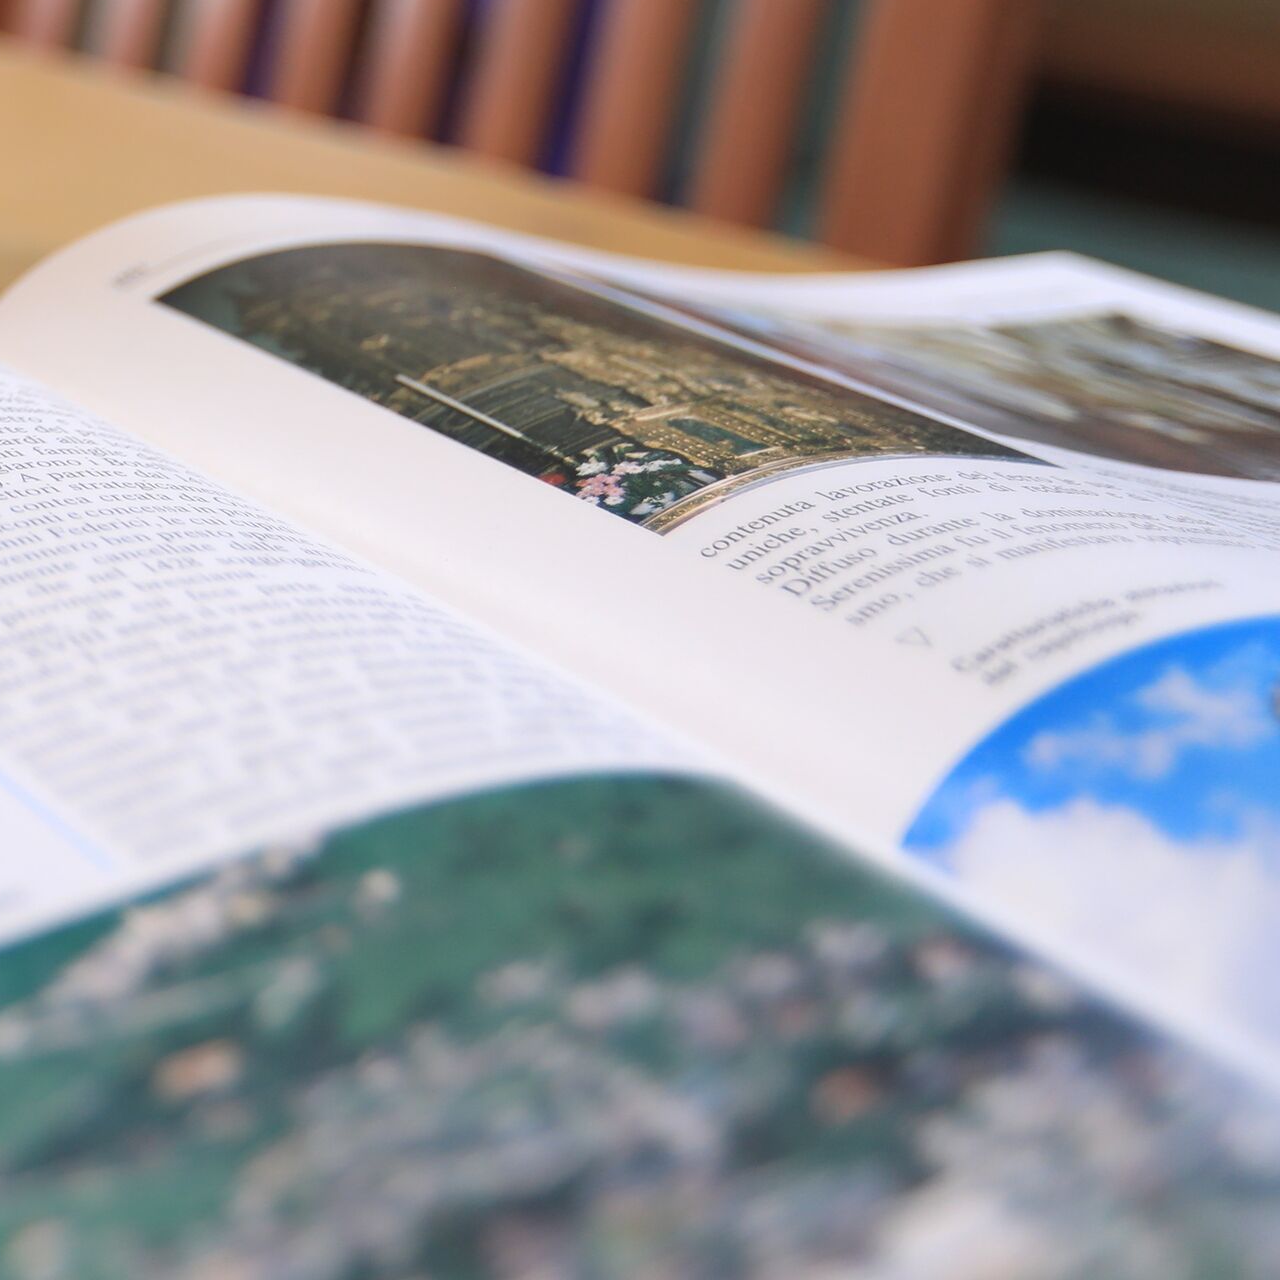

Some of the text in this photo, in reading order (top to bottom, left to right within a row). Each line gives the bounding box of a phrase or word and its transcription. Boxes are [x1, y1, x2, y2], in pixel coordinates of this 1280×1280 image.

[31, 444, 128, 459] famiglie
[19, 472, 43, 484] A
[48, 468, 130, 483] partire
[133, 469, 173, 481] dal
[8, 494, 94, 515] contea
[98, 492, 174, 504] creata
[178, 492, 209, 504] da
[67, 510, 83, 520] e
[83, 502, 190, 520] concessa
[190, 505, 218, 516] in
[699, 469, 993, 559] contenuta lavorazione del
[46, 518, 164, 539] Federici,
[158, 515, 186, 527] le
[189, 517, 228, 527] cui
[99, 532, 152, 547] ben
[155, 529, 234, 543] presto
[725, 481, 1017, 572] uniche, stentate fonti di
[92, 543, 217, 566] cancellate
[229, 540, 288, 552] dalle
[755, 510, 931, 586] sopravvivenza.
[779, 544, 878, 599] Diffuso
[886, 516, 982, 547] durante
[980, 510, 1017, 523] la
[88, 566, 128, 584] nel
[809, 519, 1130, 612] Serenissima fu il fenomeno
[844, 534, 1135, 627] smo, che si manifestava
